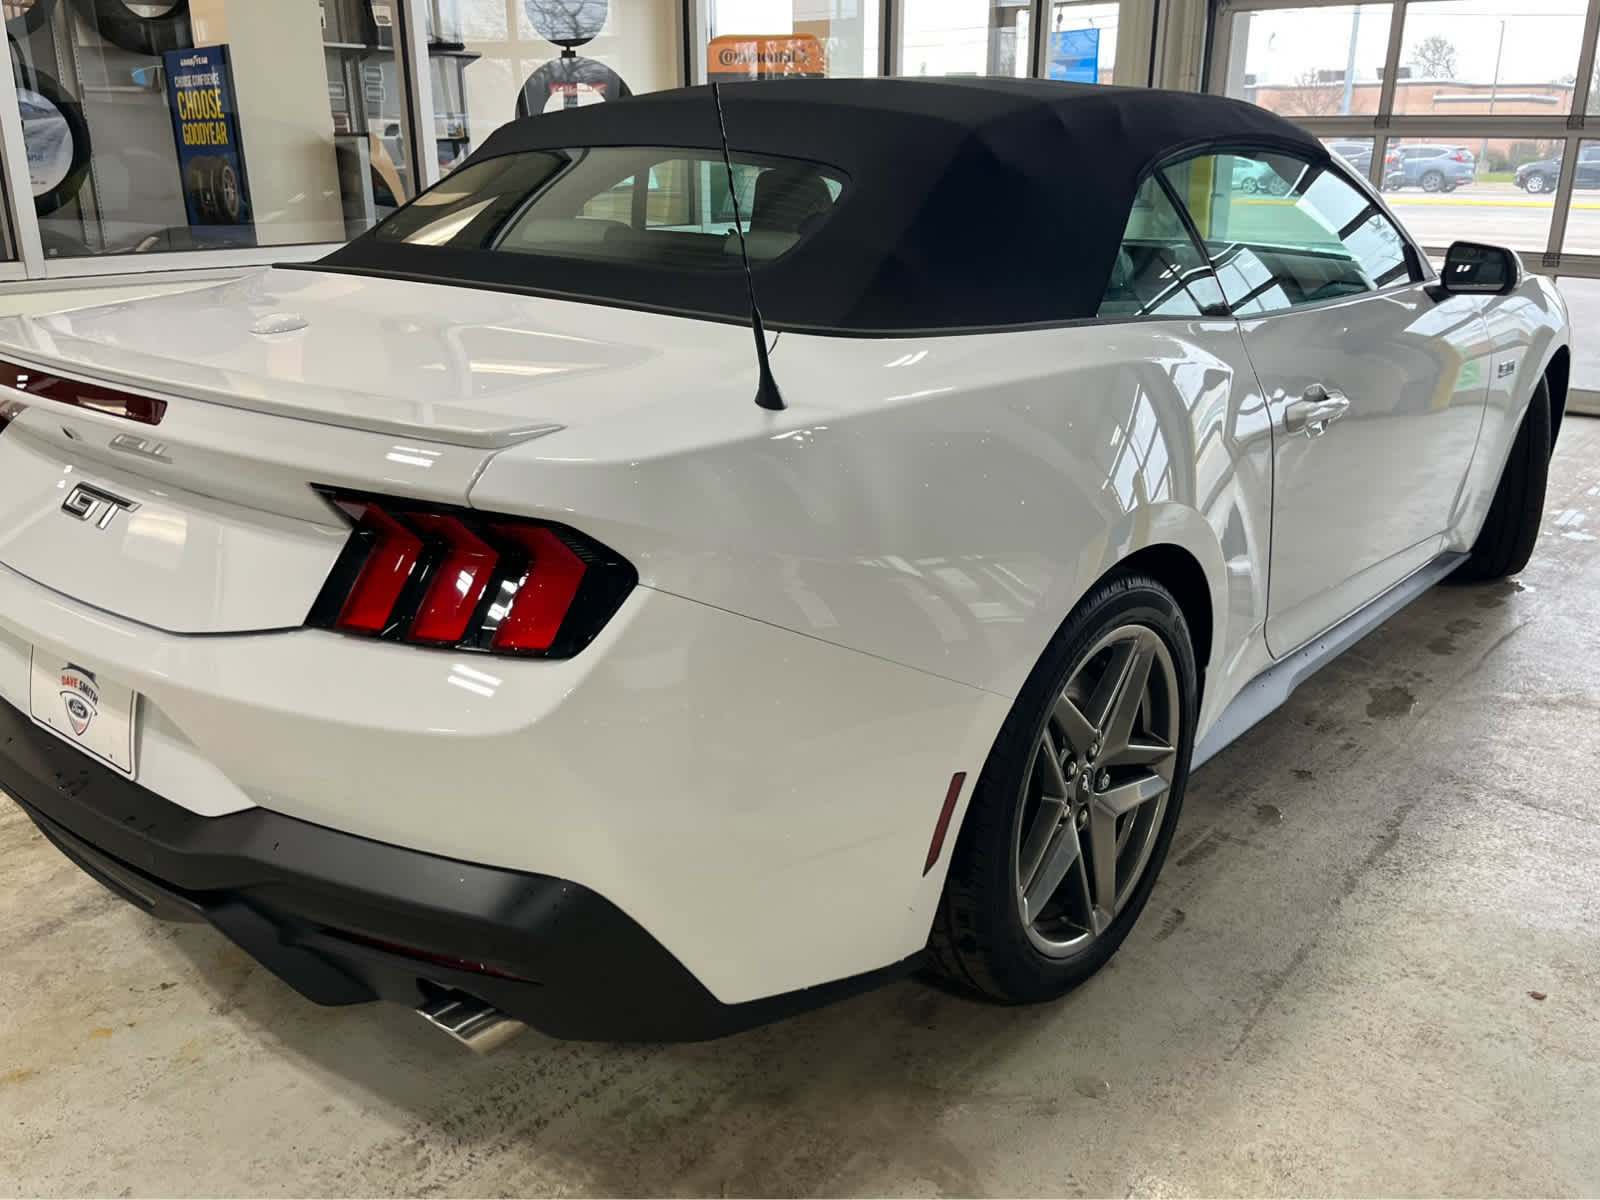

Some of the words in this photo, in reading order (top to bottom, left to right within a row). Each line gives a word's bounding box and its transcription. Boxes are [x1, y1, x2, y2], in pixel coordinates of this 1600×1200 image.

[177, 89, 225, 120] CHOOSE
[182, 122, 229, 145] GOODYEAR
[61, 481, 143, 530] GT
[62, 675, 79, 688] DAVE
[79, 680, 99, 705] SMITH
[69, 700, 88, 718] Ford
